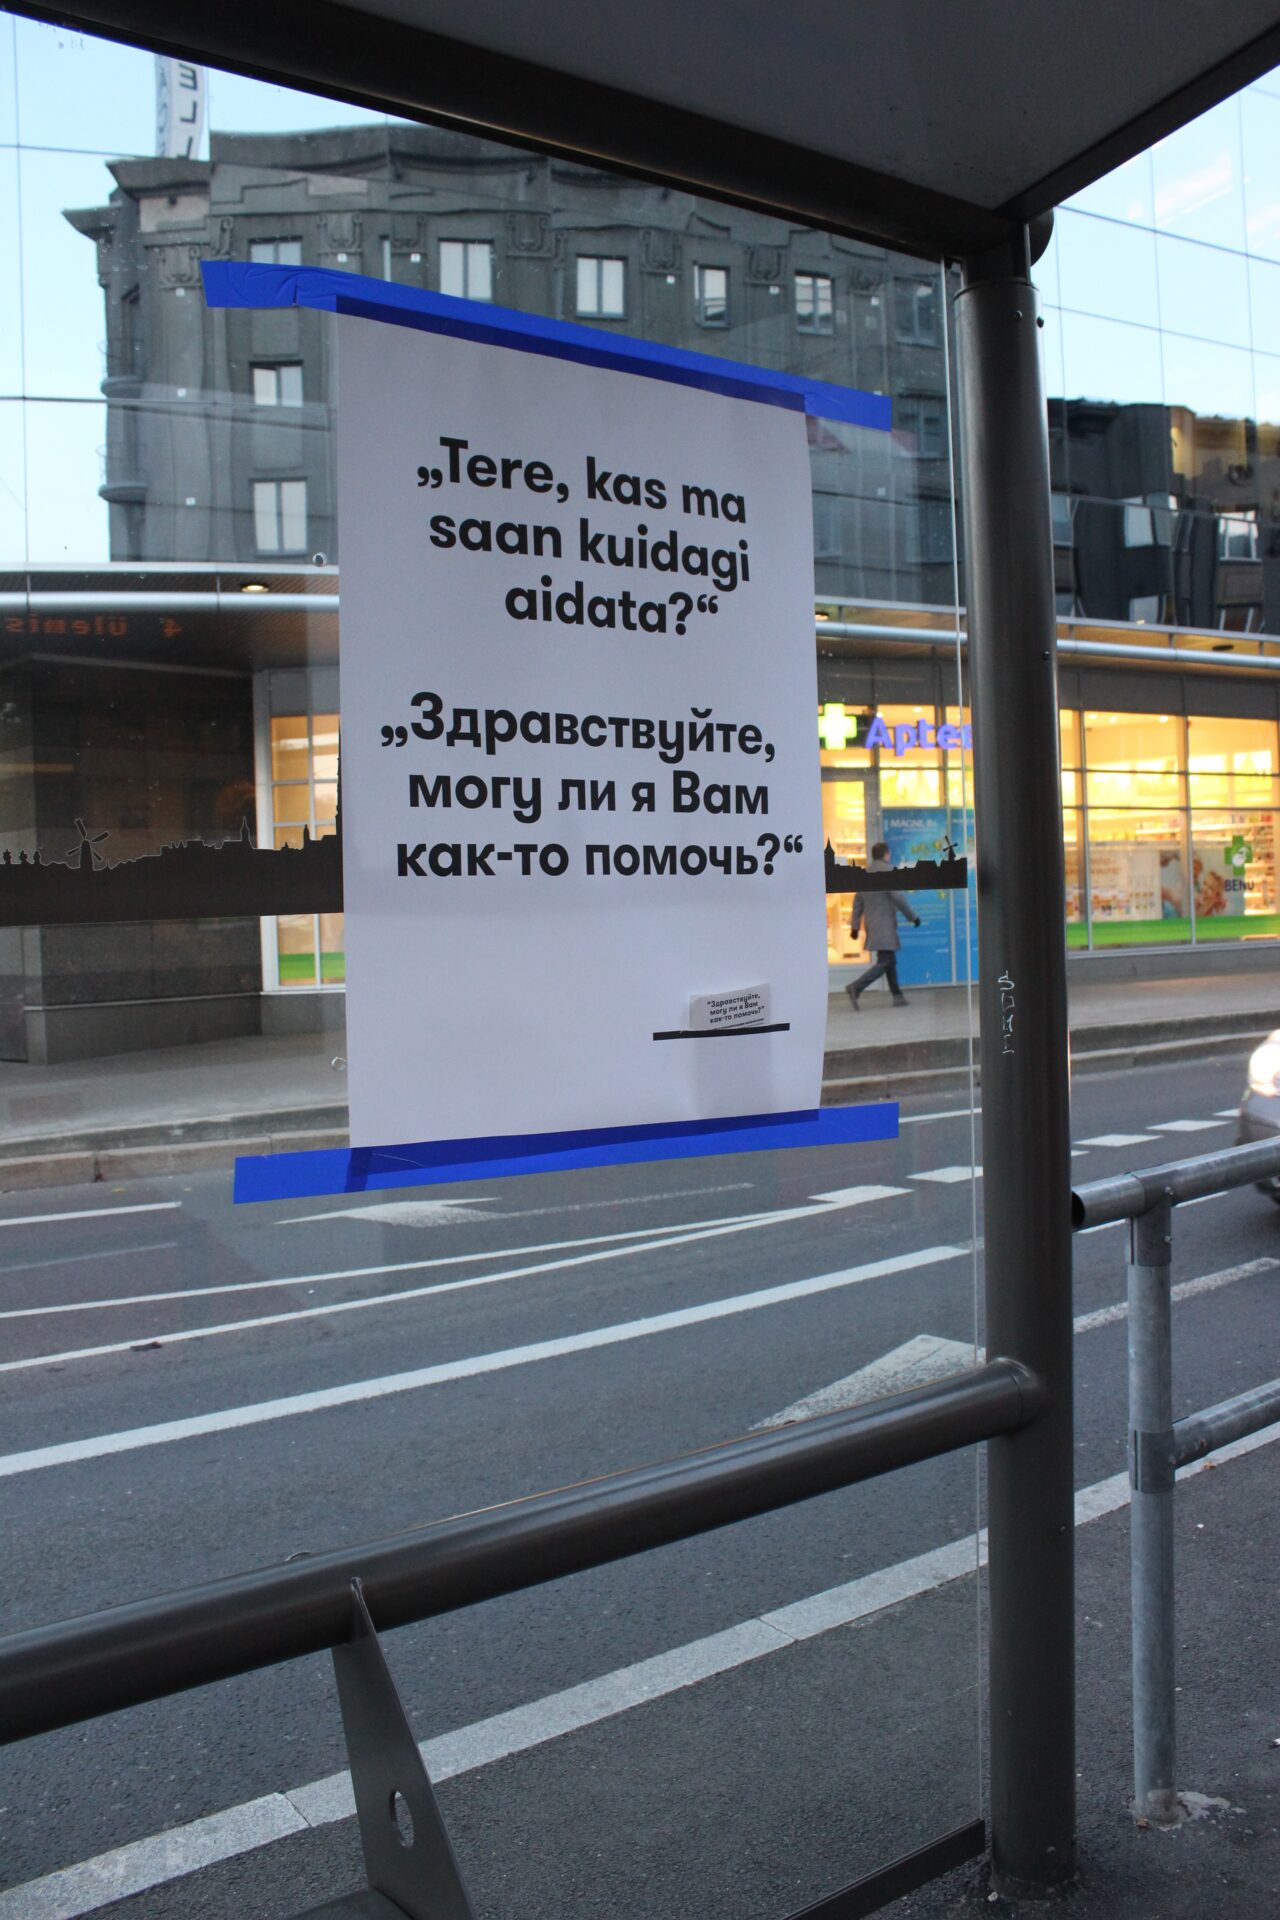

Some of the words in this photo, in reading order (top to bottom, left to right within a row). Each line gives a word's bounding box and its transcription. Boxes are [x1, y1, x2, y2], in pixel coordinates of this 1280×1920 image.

[417, 437, 569, 504] „Tere,
[587, 456, 666, 510] kas
[682, 485, 747, 524] ma
[429, 515, 561, 559] saan
[580, 518, 750, 593] kuidagi
[505, 575, 719, 636] aidata?“
[381, 692, 776, 765] „Здравствуйте,
[409, 775, 542, 824] могу
[558, 779, 616, 812] ли
[632, 782, 656, 813] я
[673, 770, 769, 815] Вам
[397, 843, 570, 878] как-то
[586, 833, 803, 876] помочь?“
[1224, 879, 1255, 892] BENU
